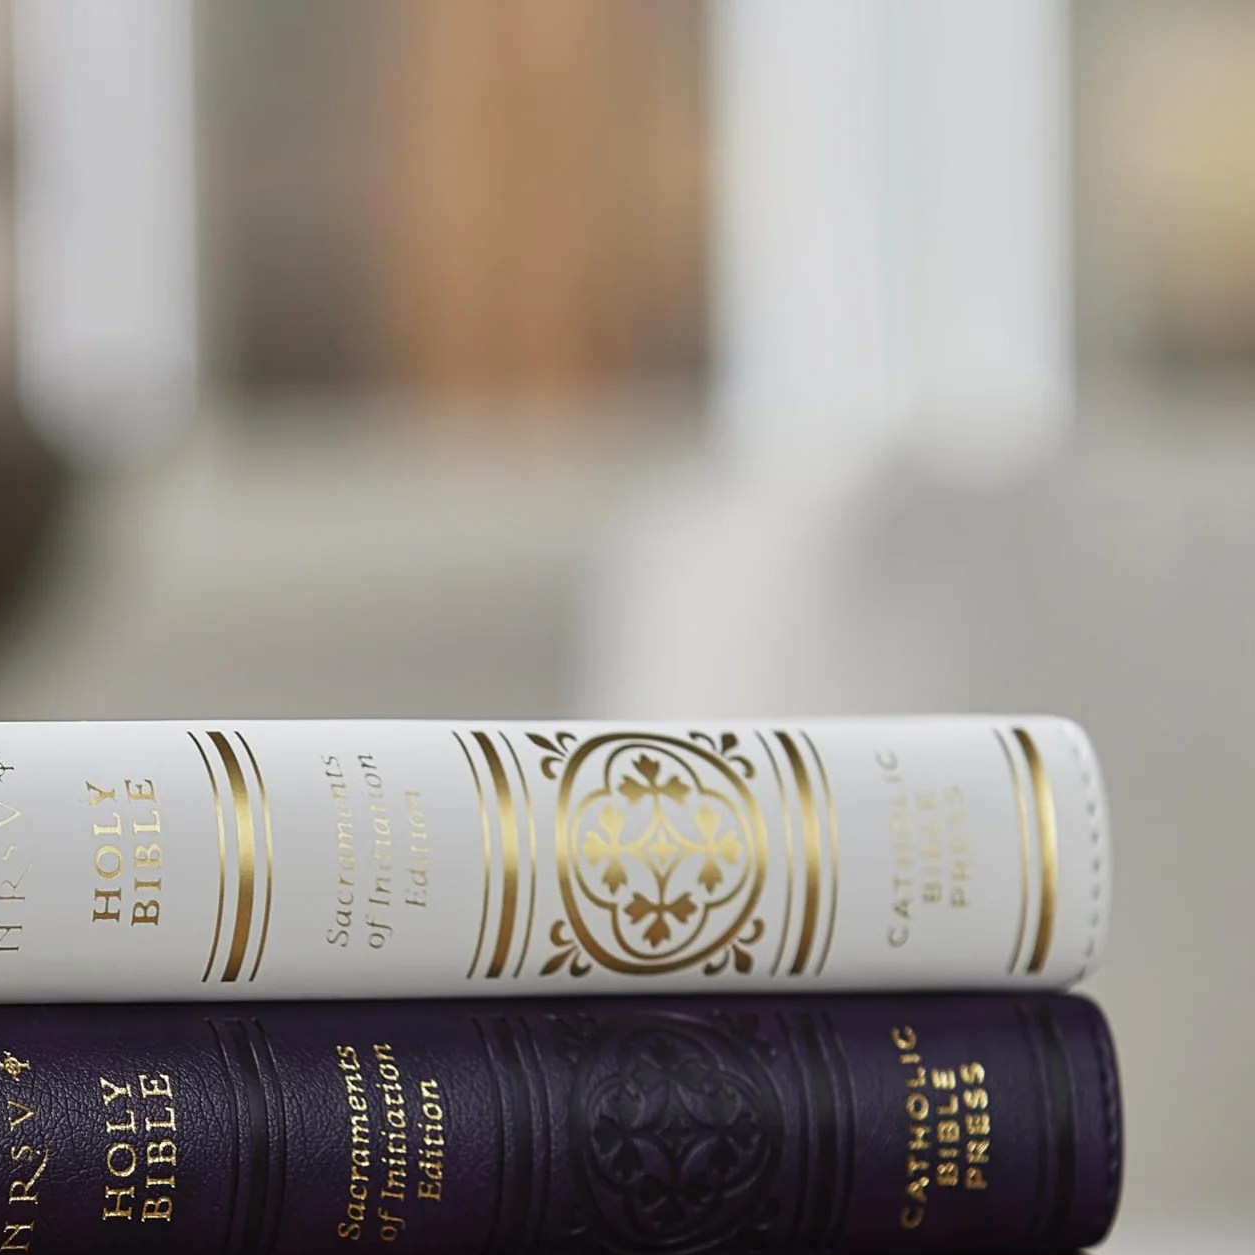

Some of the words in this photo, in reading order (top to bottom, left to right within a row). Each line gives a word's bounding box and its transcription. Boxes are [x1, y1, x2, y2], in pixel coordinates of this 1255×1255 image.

[85, 780, 124, 923] HOLY
[125, 777, 163, 927] BIBLE
[320, 754, 355, 948] Sacraments
[357, 752, 394, 908] Initiation
[403, 789, 430, 909] Edition
[366, 914, 394, 950] of
[100, 1076, 137, 1221] HOLY
[141, 1072, 179, 1223] BIBLE
[337, 1044, 371, 1242] Sacraments
[373, 1042, 407, 1202] Initiation
[418, 1079, 446, 1202] Edition
[891, 1024, 931, 1230] CATHOLIC
[931, 1068, 961, 1187] BIBLE
[960, 1060, 991, 1190] PRESS
[379, 1208, 406, 1242] of
